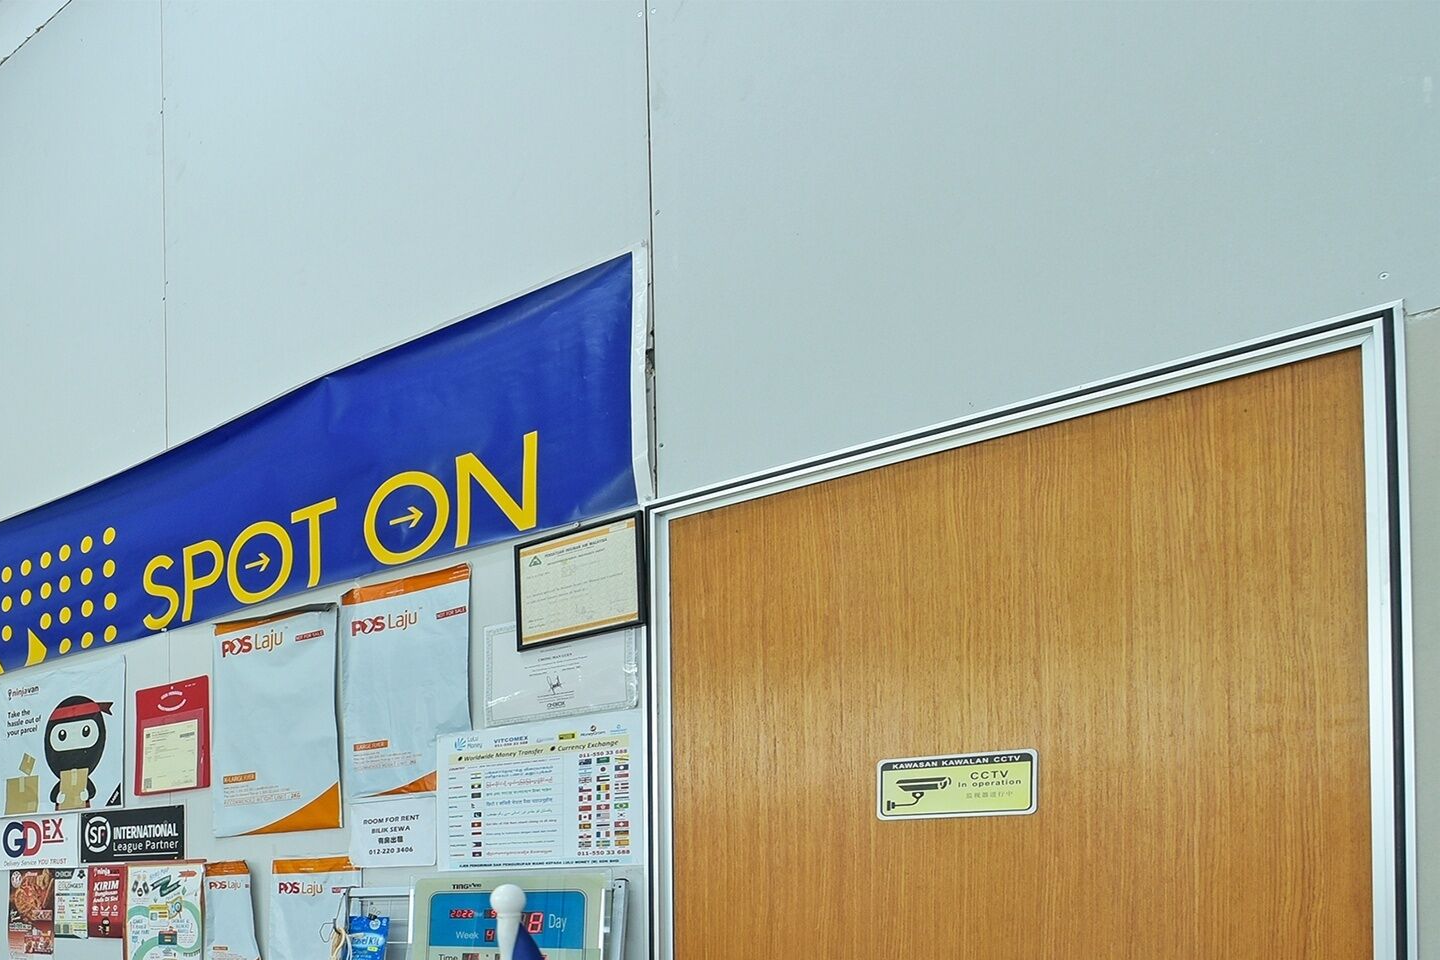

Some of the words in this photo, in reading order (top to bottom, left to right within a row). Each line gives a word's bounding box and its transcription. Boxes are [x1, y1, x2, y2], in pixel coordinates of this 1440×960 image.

[142, 498, 337, 630] SPOT
[364, 431, 538, 565] ON
[352, 616, 385, 637] POS
[388, 611, 418, 632] Laju
[221, 634, 252, 657] POS
[254, 630, 283, 652] Laju
[7, 711, 20, 719] Take
[7, 719, 23, 727] hassle
[7, 729, 20, 738] your
[20, 725, 38, 735] parcel
[494, 735, 529, 744] VITCOMEX
[464, 753, 494, 762] Worldwide
[495, 750, 516, 758] Money
[518, 748, 544, 756] Transfer
[557, 743, 586, 752] Currency
[587, 739, 619, 749] Exchange
[892, 761, 938, 770] KAWASAN
[942, 757, 989, 766] KAWALAN
[993, 754, 1021, 762] CCTV
[970, 770, 1009, 780] CCTV
[972, 779, 1022, 788] operation
[3, 818, 64, 858] GDEX
[113, 823, 178, 840] INTERNATIONAL
[113, 841, 143, 853] League
[145, 840, 179, 850] Partner
[368, 847, 395, 855] 012-220
[94, 880, 120, 891] KIRIM
[209, 881, 227, 890] POS
[227, 880, 241, 890] Laju
[278, 882, 300, 894] POS
[301, 881, 323, 896] Laju
[450, 909, 474, 918] 2022
[527, 912, 544, 934] 8
[548, 913, 568, 932] Day
[455, 931, 479, 940] Week
[486, 931, 495, 941] 4
